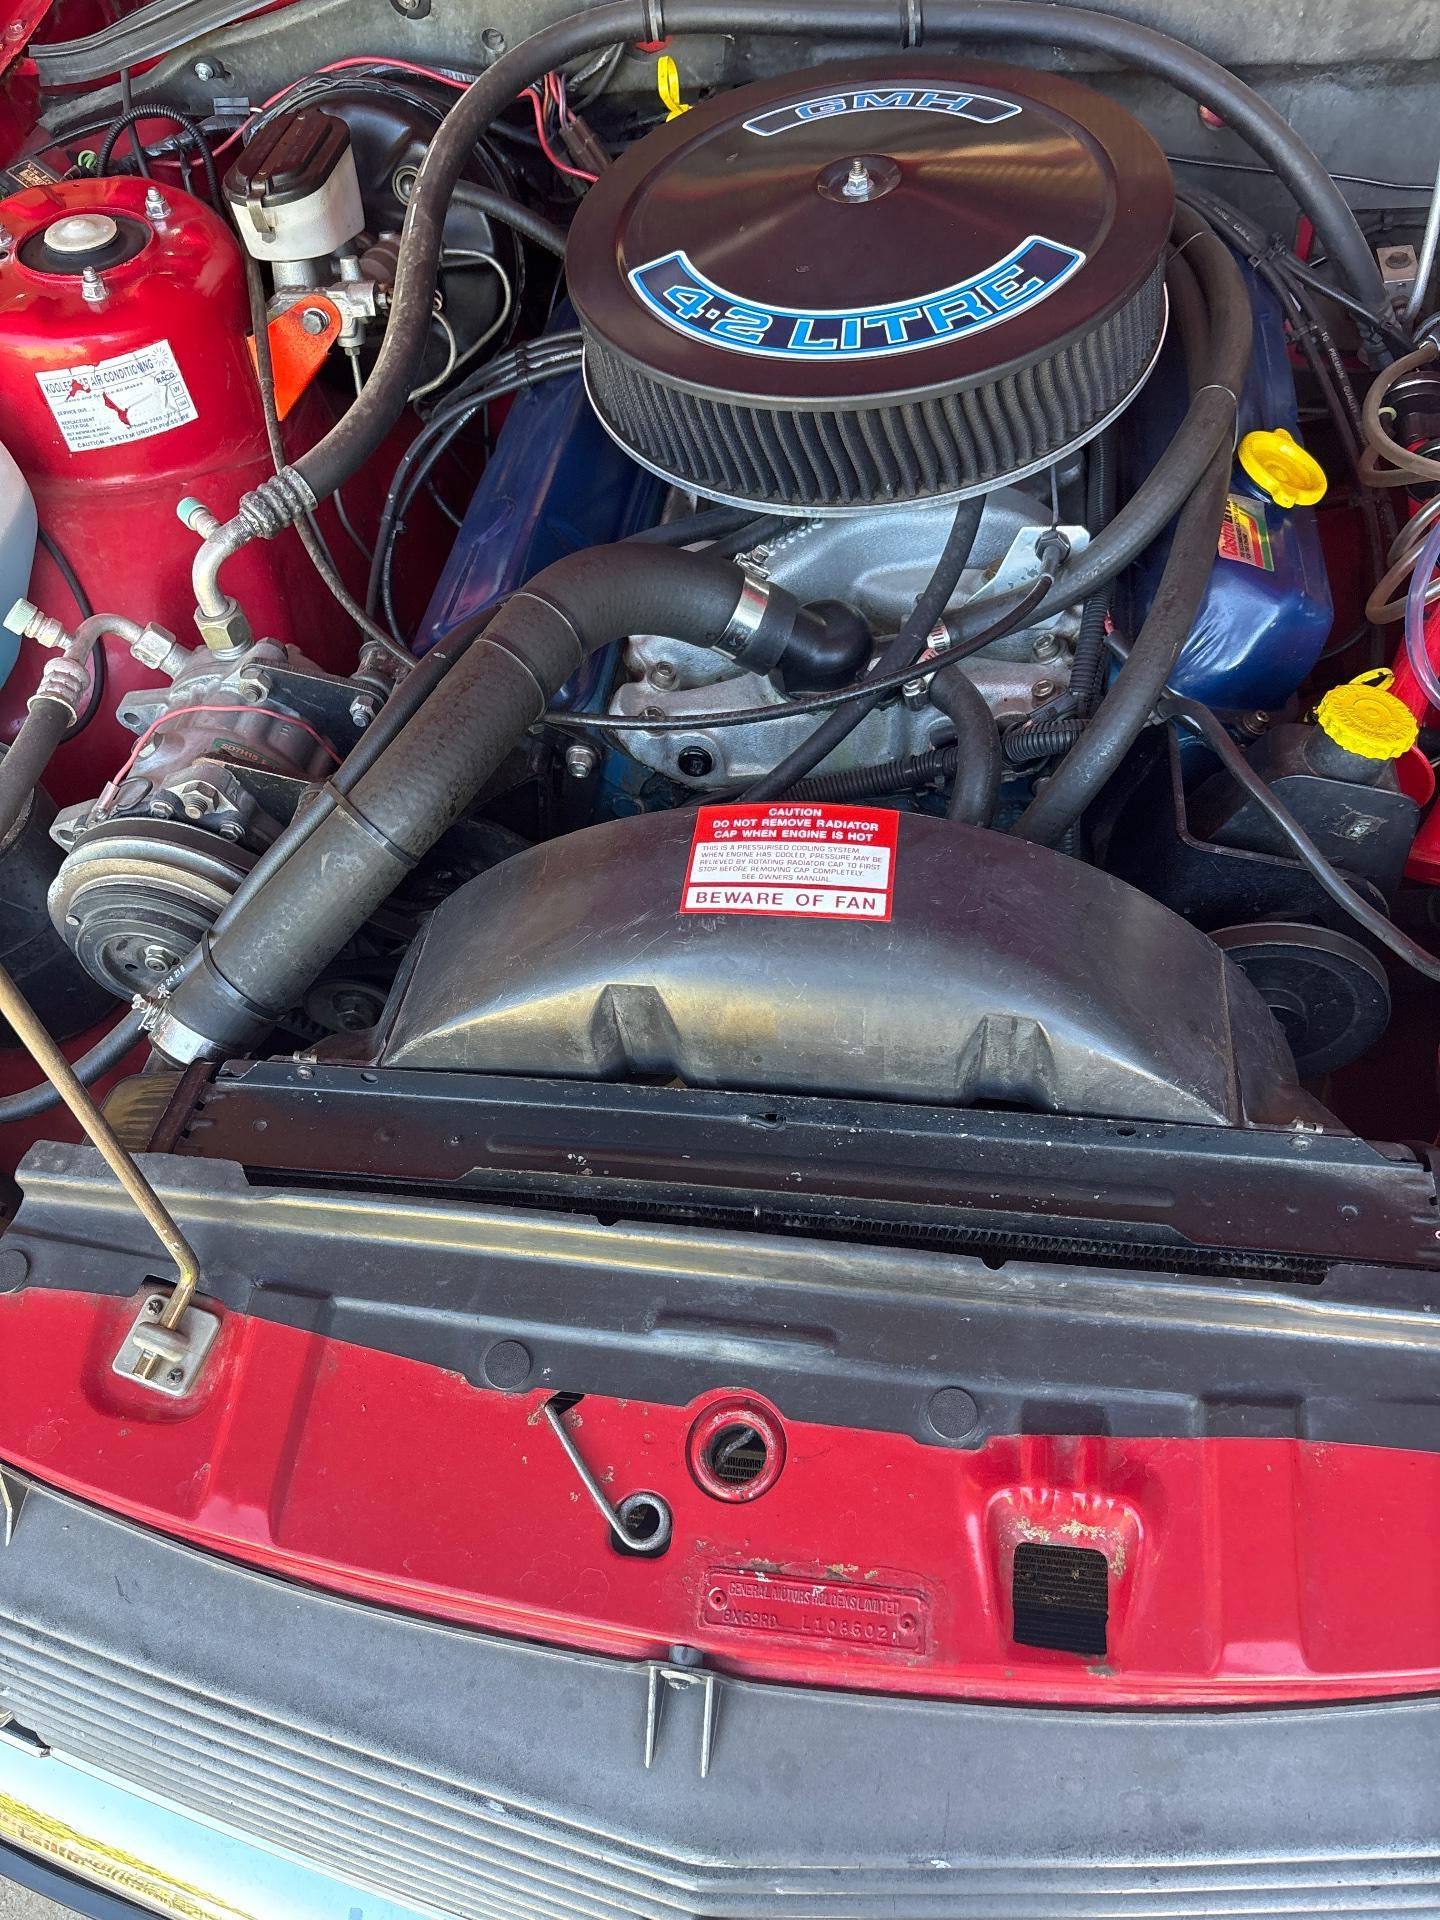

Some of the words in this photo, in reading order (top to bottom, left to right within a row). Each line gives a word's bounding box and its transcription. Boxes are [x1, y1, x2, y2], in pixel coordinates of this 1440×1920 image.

[795, 91, 973, 120] GMH
[786, 264, 1045, 351] LITRE
[91, 374, 103, 386] AIR
[77, 440, 105, 448] CAUTION
[109, 433, 135, 442] SYSTEM
[136, 426, 158, 436] UNDER
[769, 808, 822, 816] CAUTION
[734, 819, 757, 827] NOT
[762, 819, 811, 828] REMOVE
[817, 819, 878, 831] RADIATOR
[714, 830, 737, 838] CAP
[742, 830, 777, 838] WHEN
[782, 830, 827, 838] ENGINE
[832, 831, 843, 839] IS
[848, 832, 873, 842] HOT
[696, 892, 784, 905] BEWARE
[795, 894, 824, 907] OF
[835, 896, 876, 910] FAN
[729, 1581, 771, 1600] GENERAL
